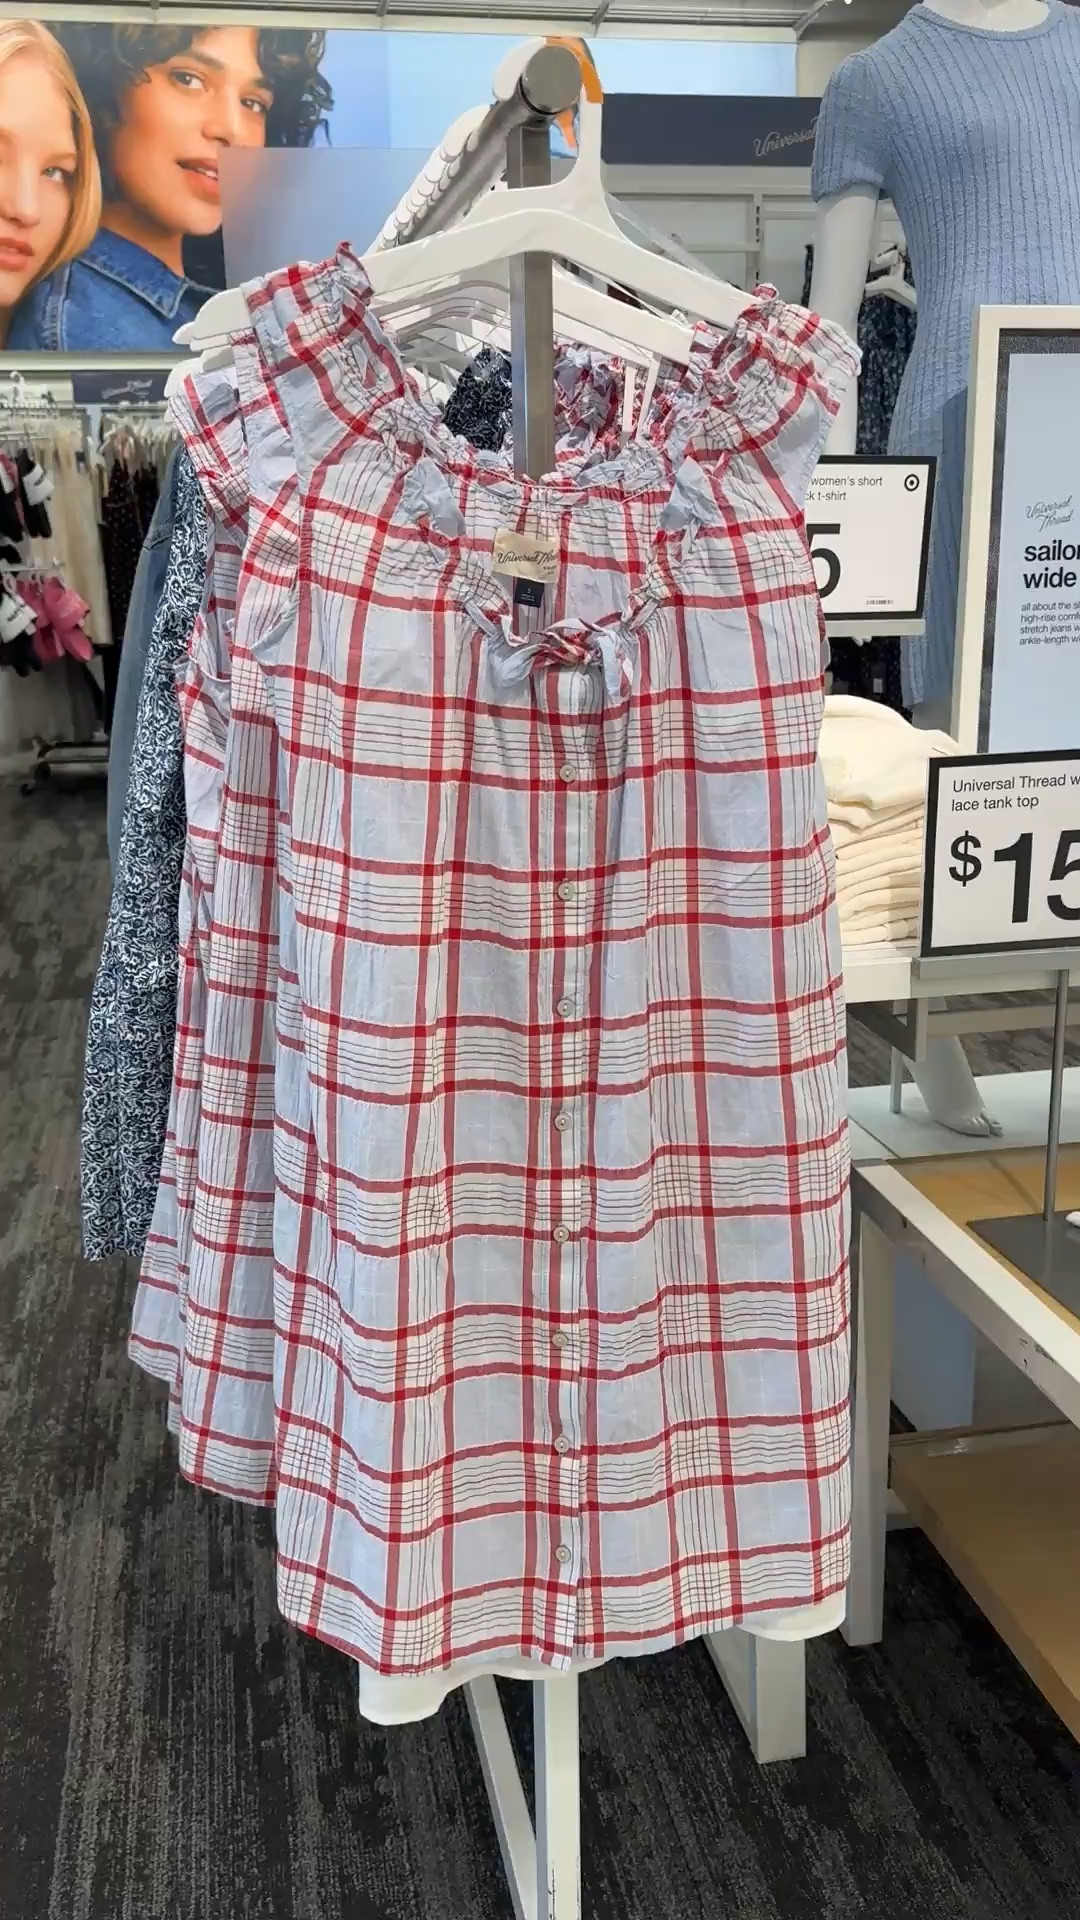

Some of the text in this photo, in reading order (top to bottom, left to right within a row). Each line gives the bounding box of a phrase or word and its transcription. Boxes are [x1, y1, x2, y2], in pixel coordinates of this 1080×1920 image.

[810, 476, 883, 486] women's short
[818, 490, 847, 501] t-shirt
[1023, 566, 1077, 589] wide
[1021, 602, 1031, 611] all
[1032, 602, 1056, 611] about
[1058, 601, 1071, 610] the
[1020, 612, 1080, 624] high-rise comf
[1020, 624, 1048, 634] stretch
[1050, 624, 1071, 635] jeans
[1019, 635, 1069, 646] ankle-length
[953, 777, 1015, 792] Universal
[1019, 774, 1066, 789] Thread
[952, 796, 1039, 811] lace tank top
